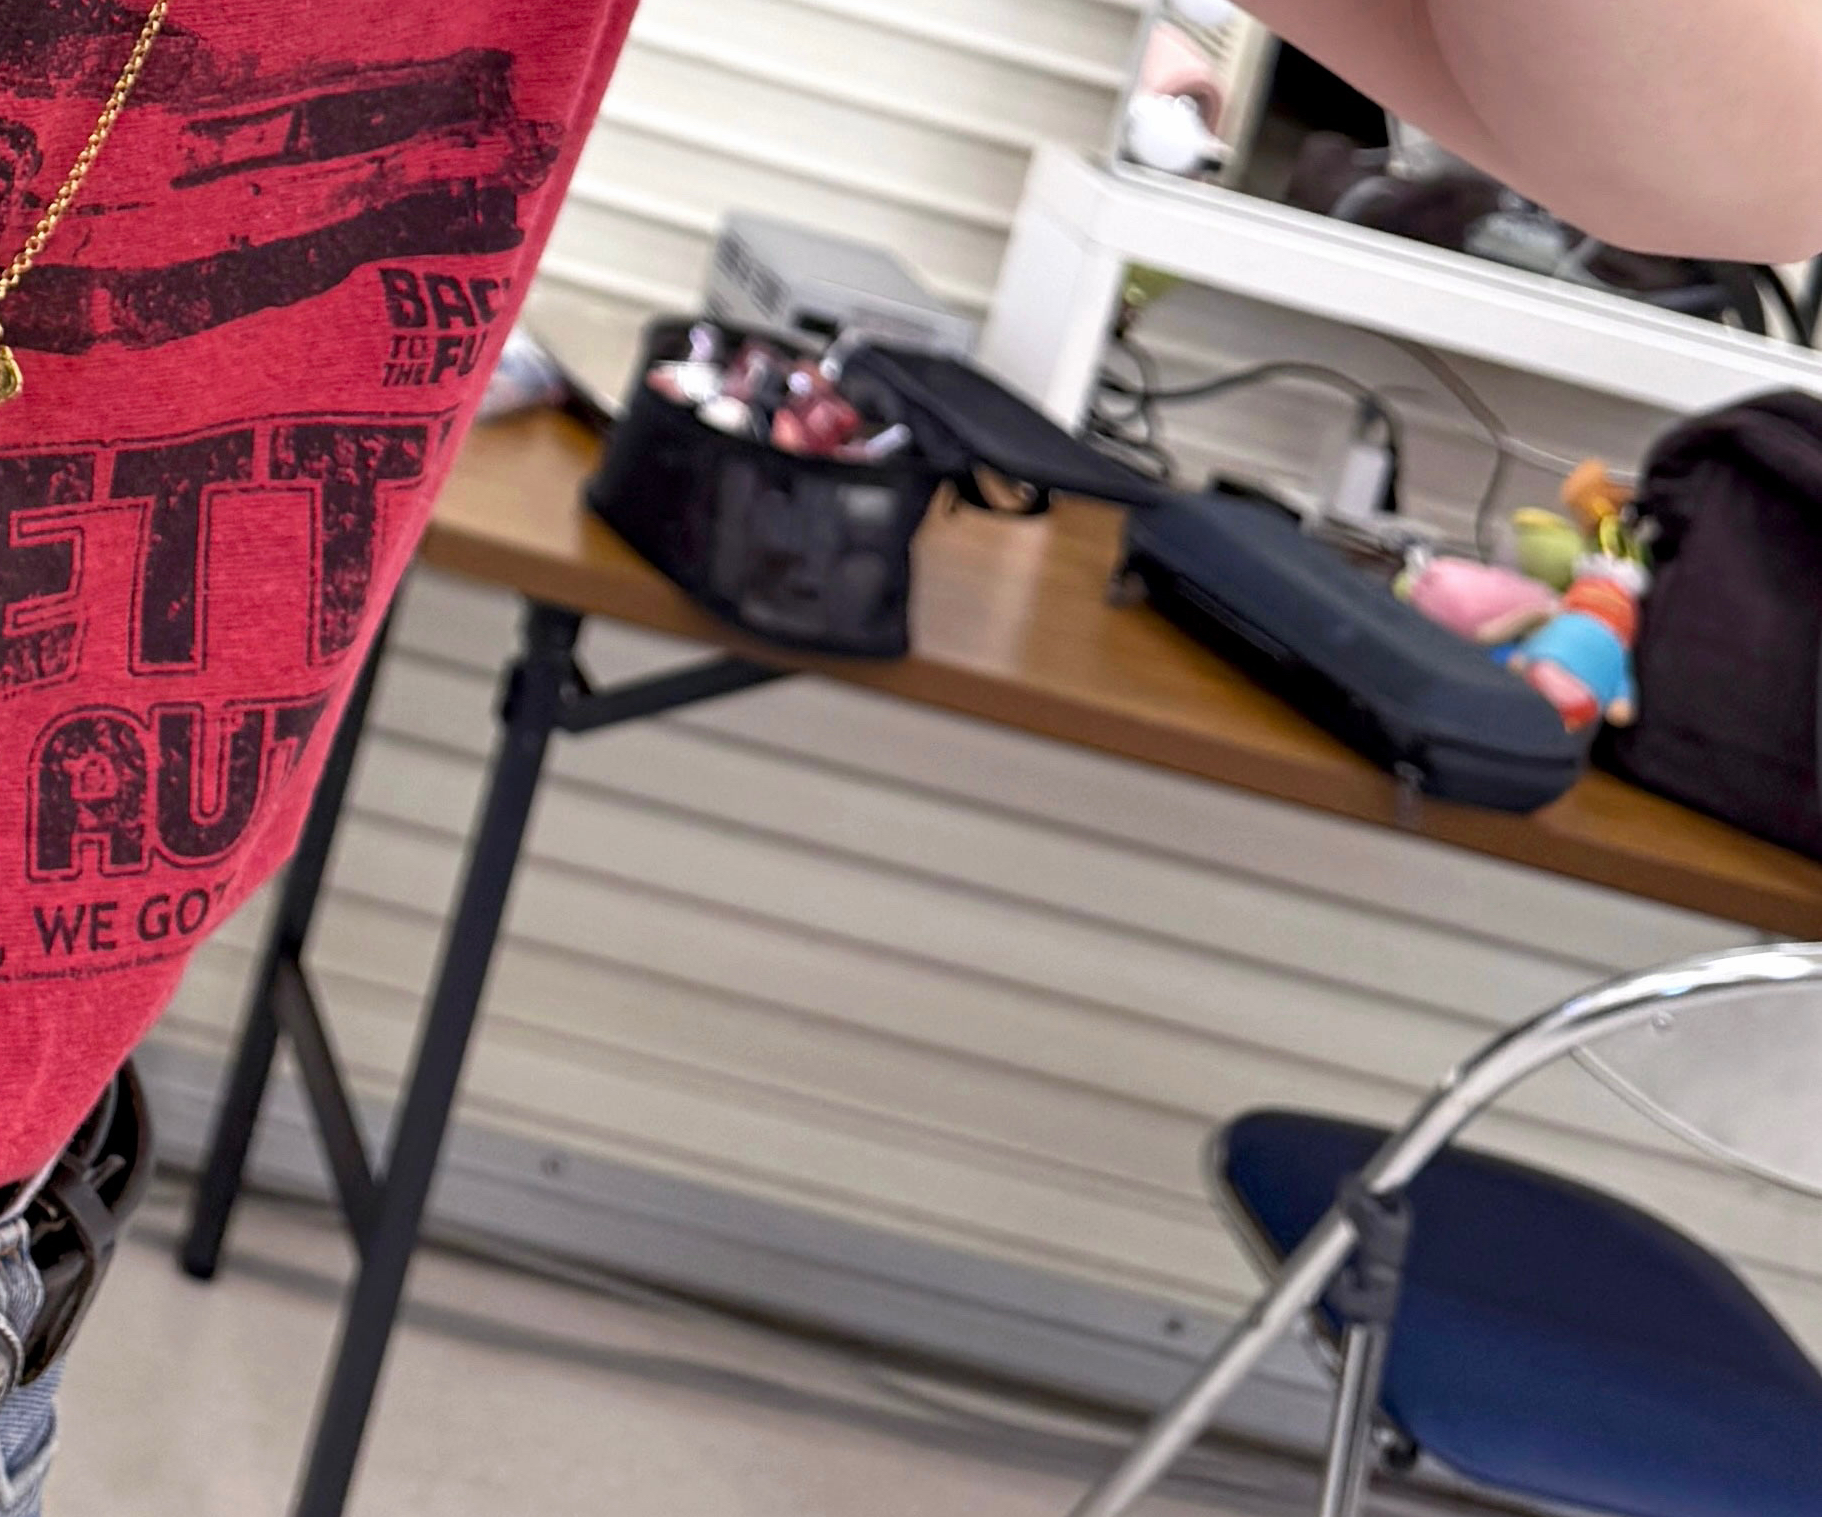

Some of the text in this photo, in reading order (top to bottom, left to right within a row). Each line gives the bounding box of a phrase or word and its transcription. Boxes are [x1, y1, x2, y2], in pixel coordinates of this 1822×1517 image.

[378, 268, 511, 329] BAC
[390, 334, 428, 360] TO
[382, 362, 429, 387] THE
[33, 901, 119, 956] WE
